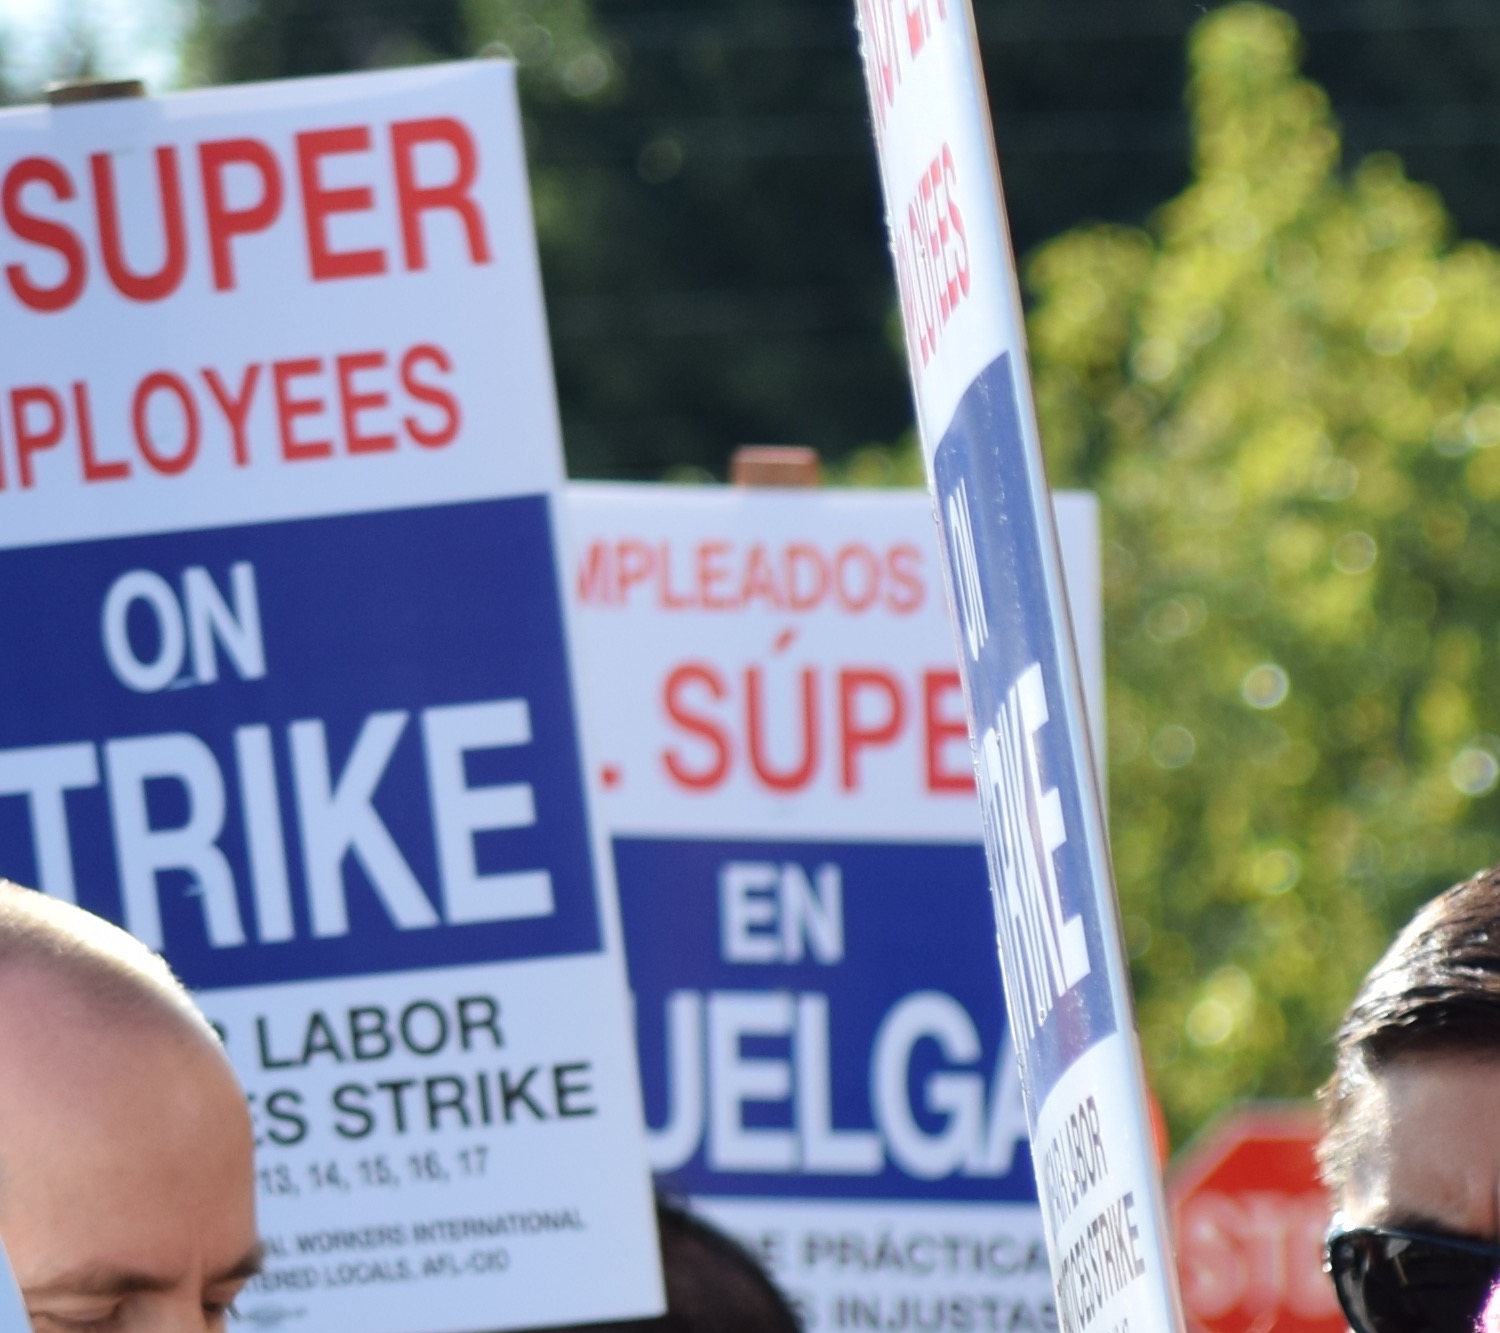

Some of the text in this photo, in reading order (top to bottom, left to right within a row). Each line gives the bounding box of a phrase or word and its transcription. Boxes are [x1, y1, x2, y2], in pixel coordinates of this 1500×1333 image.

[1, 116, 493, 315] SUPER
[0, 342, 464, 492] PLOYEES
[102, 562, 266, 692] ON
[577, 539, 927, 616] MPLEADOS
[949, 477, 989, 661] ON
[660, 627, 980, 797] SÚPE
[0, 698, 556, 950] TRIKE
[719, 860, 844, 966] EN
[255, 995, 504, 1071] LABOR
[636, 989, 1037, 1182] UELG
[331, 1062, 596, 1141] STRIKE
[456, 1143, 489, 1176] 17
[1065, 1095, 1109, 1209] LABOR
[296, 1226, 406, 1255] WORKERS
[411, 1210, 583, 1244] INTERNATIONAL
[804, 1222, 1052, 1276] PRÁCTICA
[1086, 1191, 1146, 1309] STRIKE
